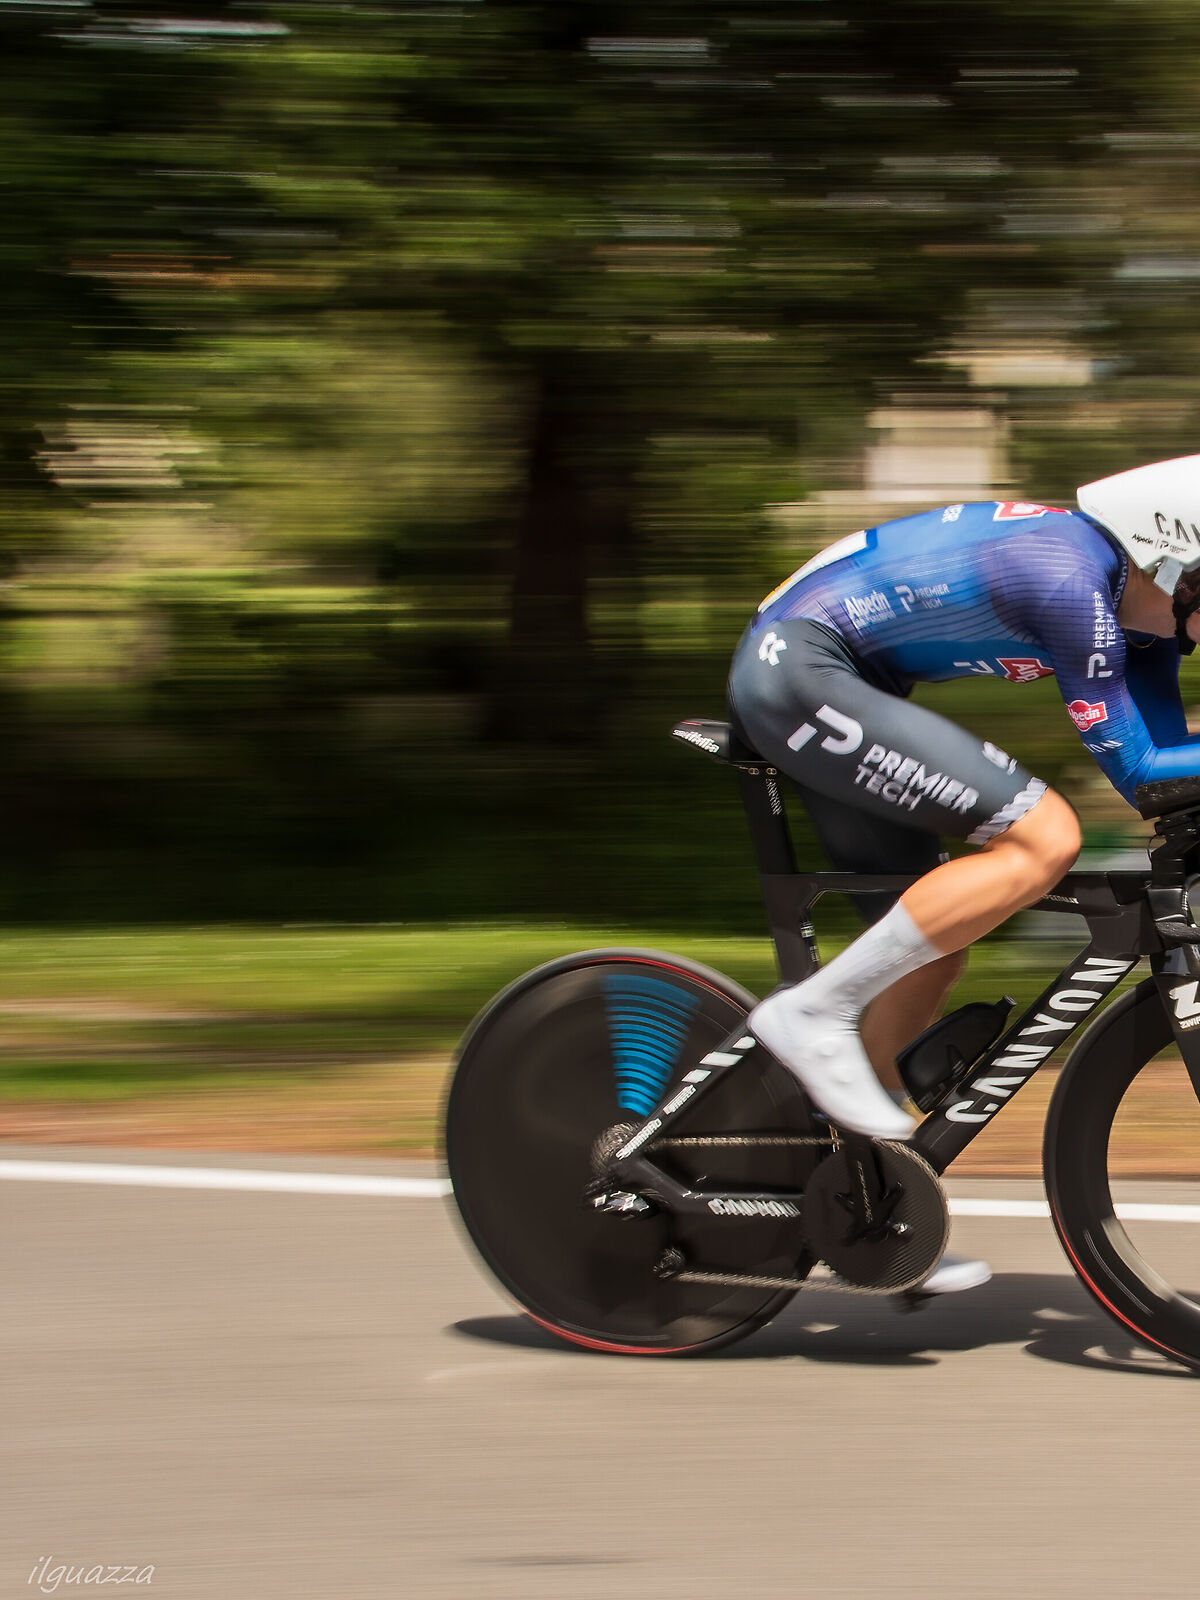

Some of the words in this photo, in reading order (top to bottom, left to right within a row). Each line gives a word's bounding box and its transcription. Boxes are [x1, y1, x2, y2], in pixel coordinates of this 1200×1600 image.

[844, 589, 893, 621] Alpecin
[914, 583, 951, 600] PREMIER
[1092, 590, 1107, 649] PREMIER
[1106, 613, 1116, 648] TECH
[854, 763, 925, 812] TECH
[863, 743, 980, 815] PREMIER
[945, 957, 1135, 1124] CANYON
